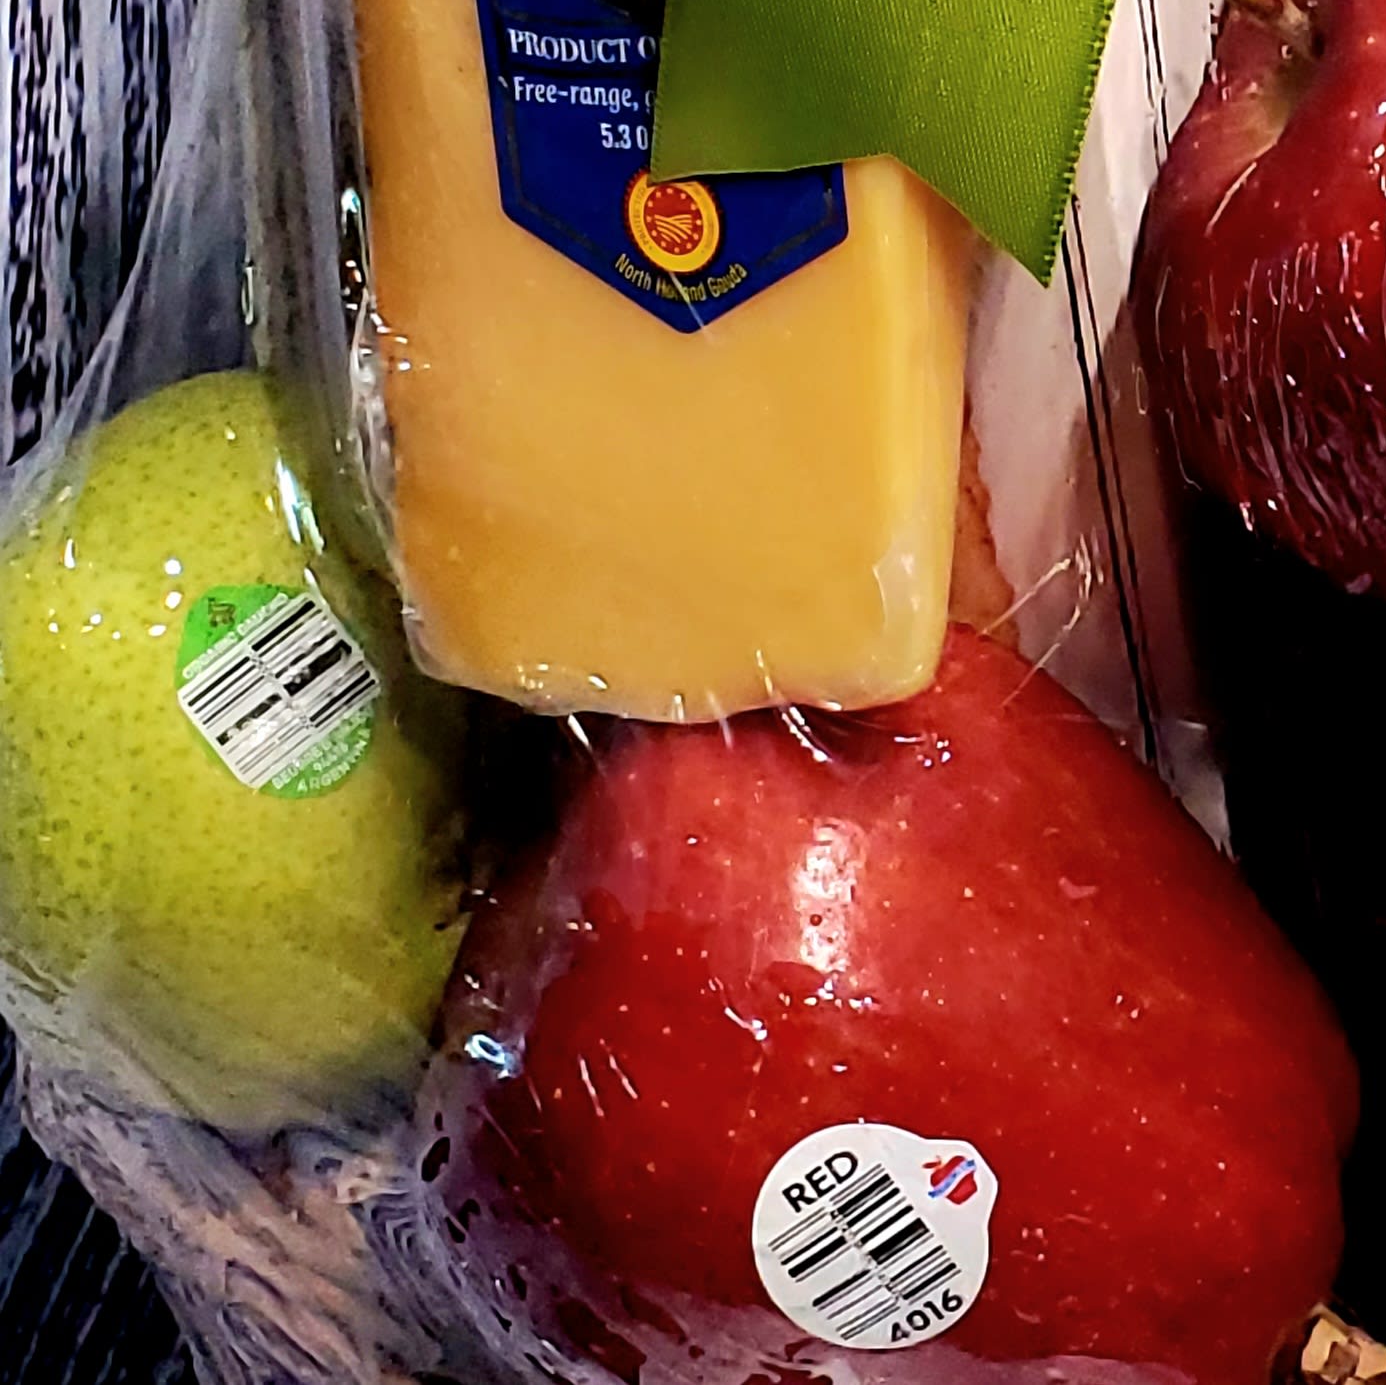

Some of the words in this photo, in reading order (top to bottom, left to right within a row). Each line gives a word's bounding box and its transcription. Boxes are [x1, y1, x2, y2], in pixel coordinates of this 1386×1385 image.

[506, 26, 632, 65] PRODUCT
[513, 75, 640, 114] Free-range,
[599, 121, 632, 150] 5.3
[614, 252, 652, 291] North
[707, 262, 748, 298] Gouda
[781, 1150, 860, 1214] RED
[890, 1288, 964, 1343] 4016
